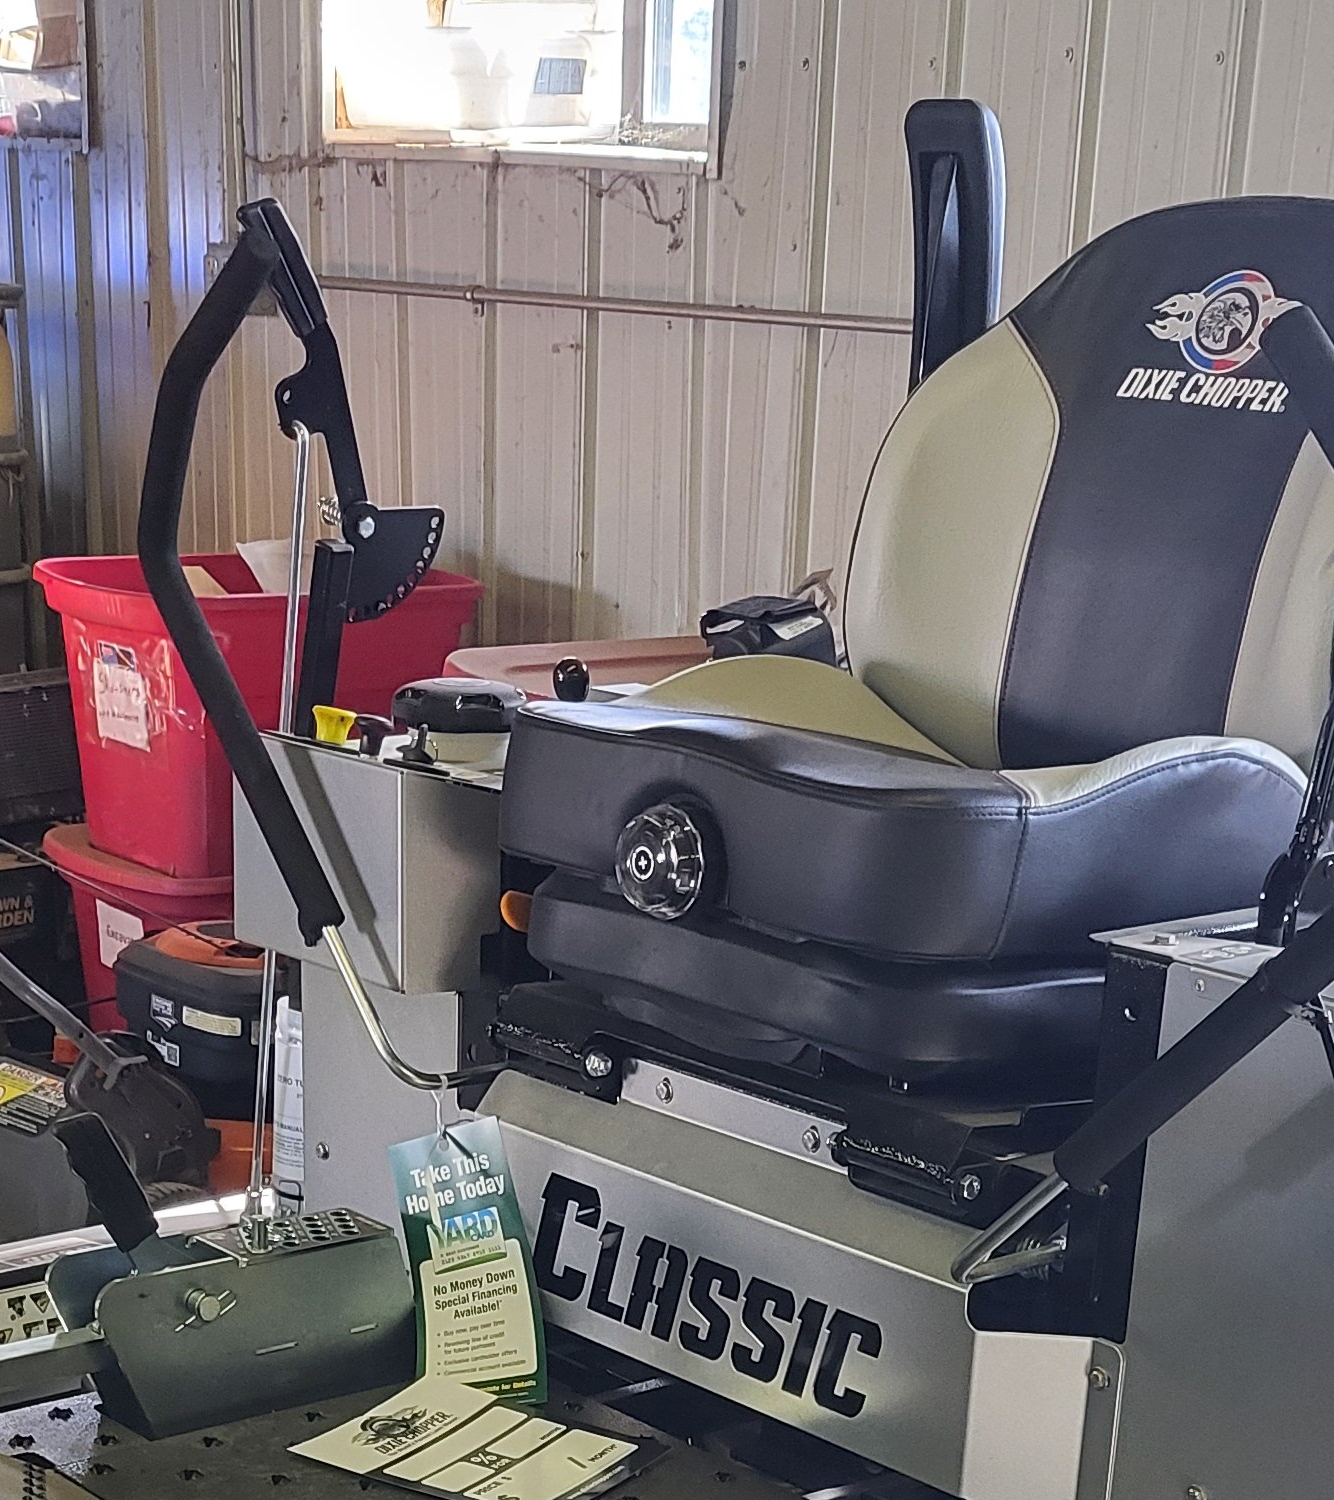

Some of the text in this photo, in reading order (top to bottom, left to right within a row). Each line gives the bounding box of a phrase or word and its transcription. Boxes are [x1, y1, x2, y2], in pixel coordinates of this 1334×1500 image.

[1116, 367, 1289, 413] DIXIE CHOPPER
[23, 895, 33, 907] &
[410, 1152, 490, 1188] Take This
[455, 1174, 505, 1201] Today
[429, 1209, 498, 1248] YARD
[433, 1269, 515, 1296] No Money Down
[532, 1172, 882, 1419] CLASSIC
[435, 1284, 518, 1310] Special Financing
[374, 1438, 407, 1454] DIXIE
[407, 1411, 451, 1440] CHOPPER
[469, 1452, 497, 1464] %
[491, 1458, 512, 1469] FOR
